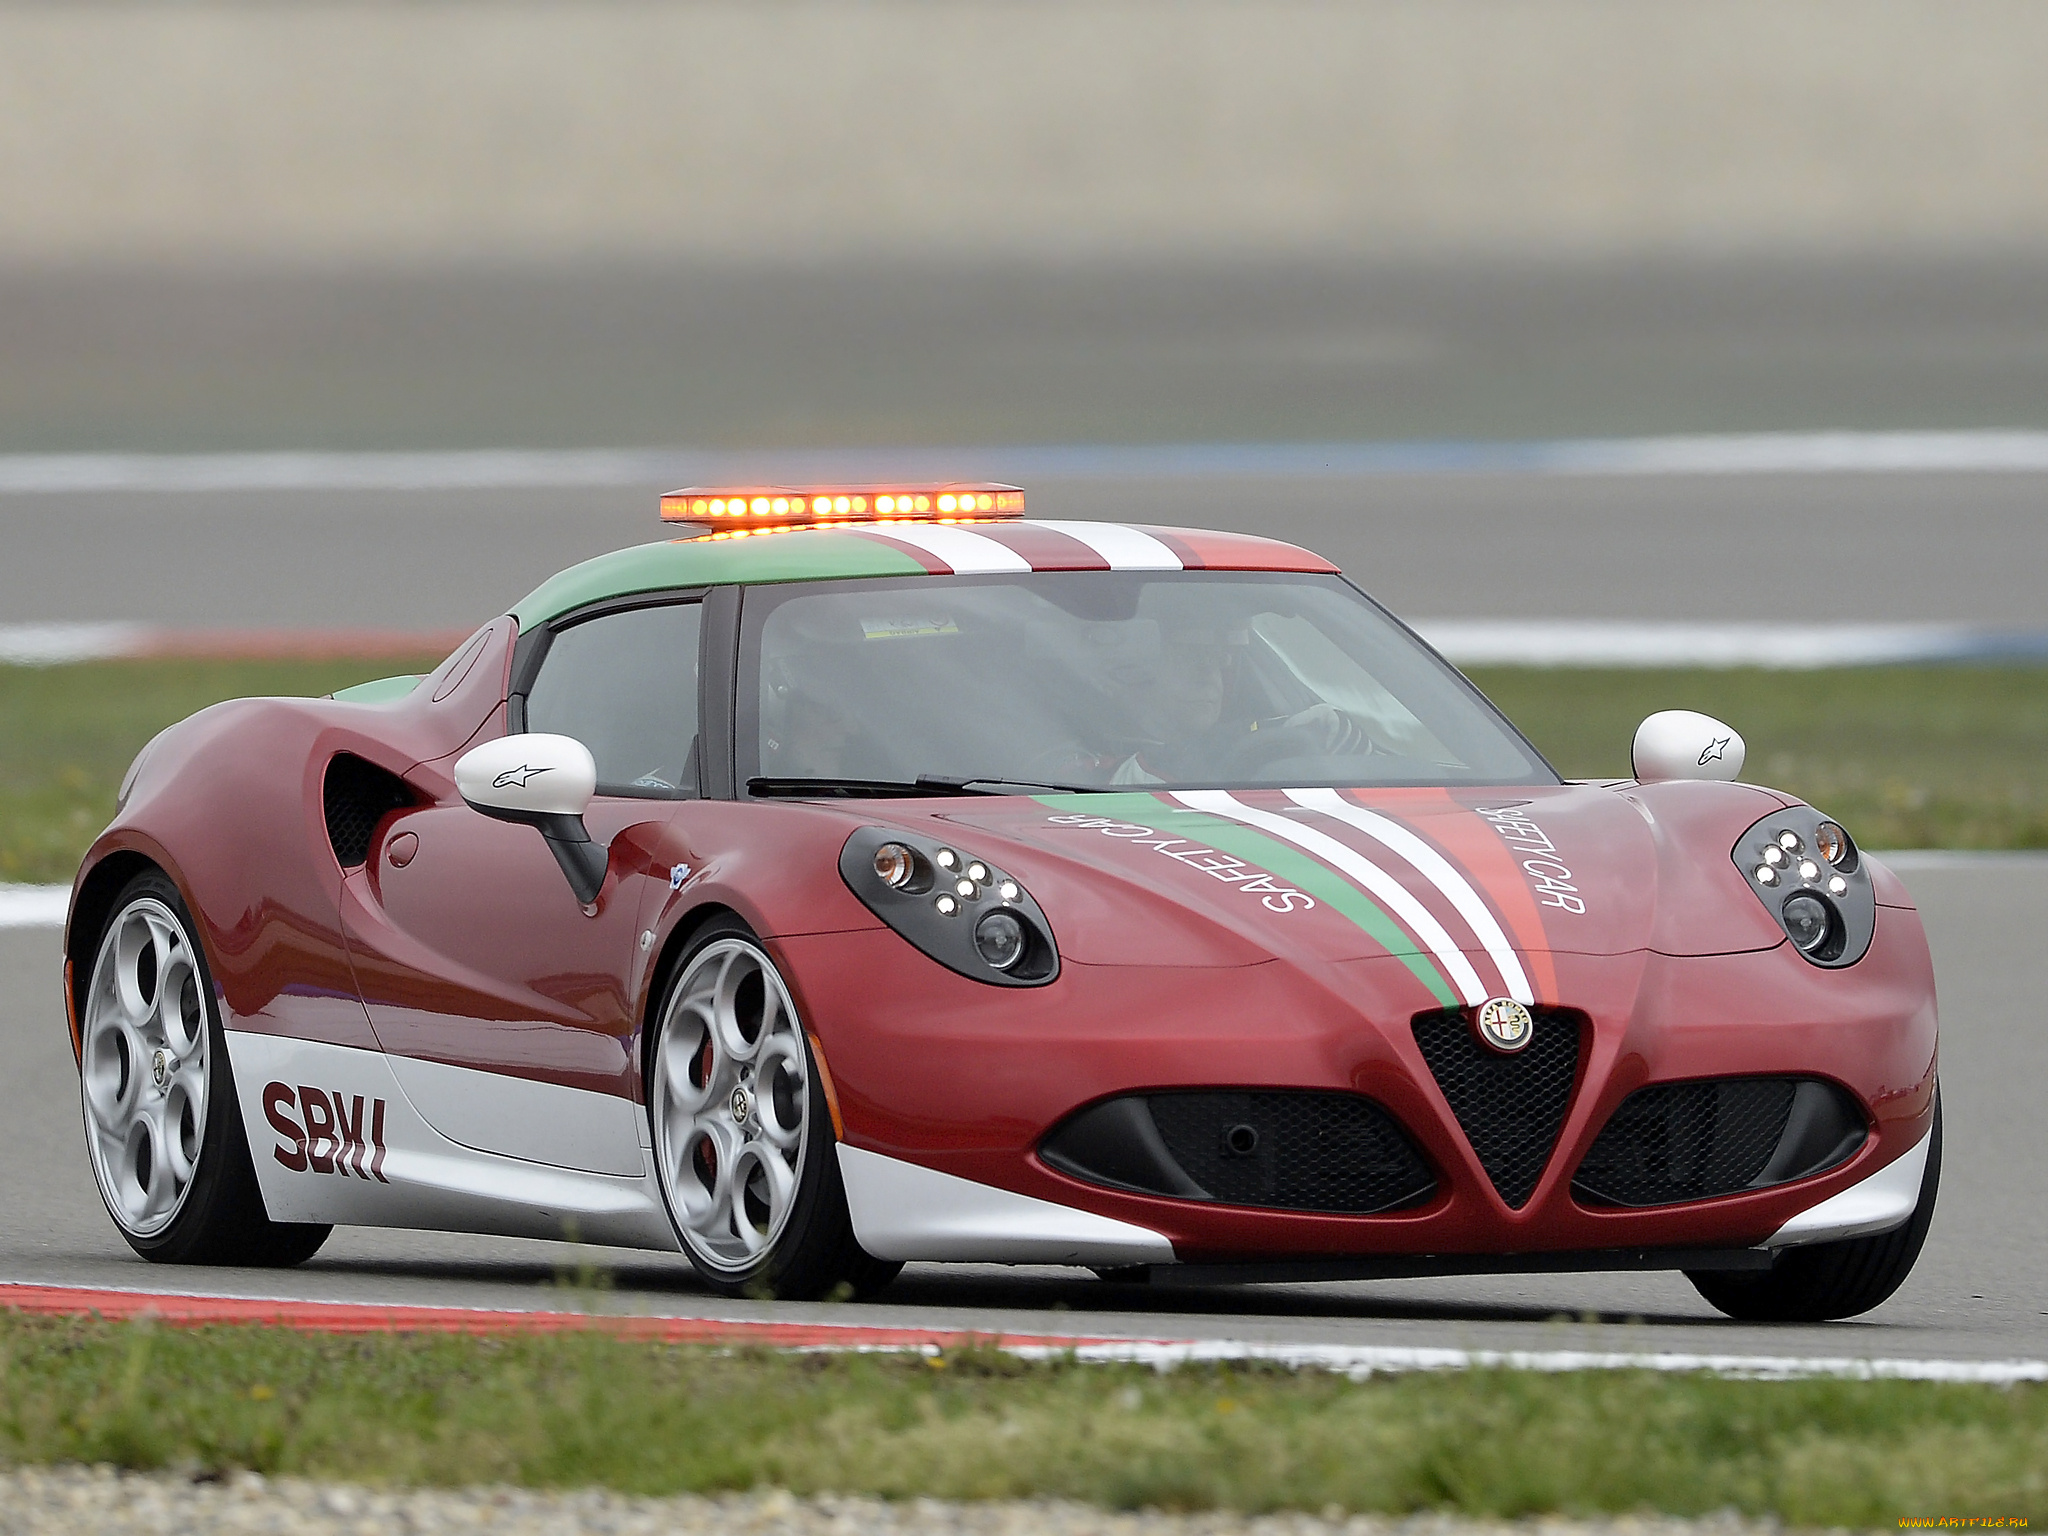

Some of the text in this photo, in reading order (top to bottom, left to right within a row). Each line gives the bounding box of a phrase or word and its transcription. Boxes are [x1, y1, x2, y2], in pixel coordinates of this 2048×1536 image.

[1047, 814, 1316, 913] SAFETY CAR
[1475, 807, 1587, 914] SAFETY CAR
